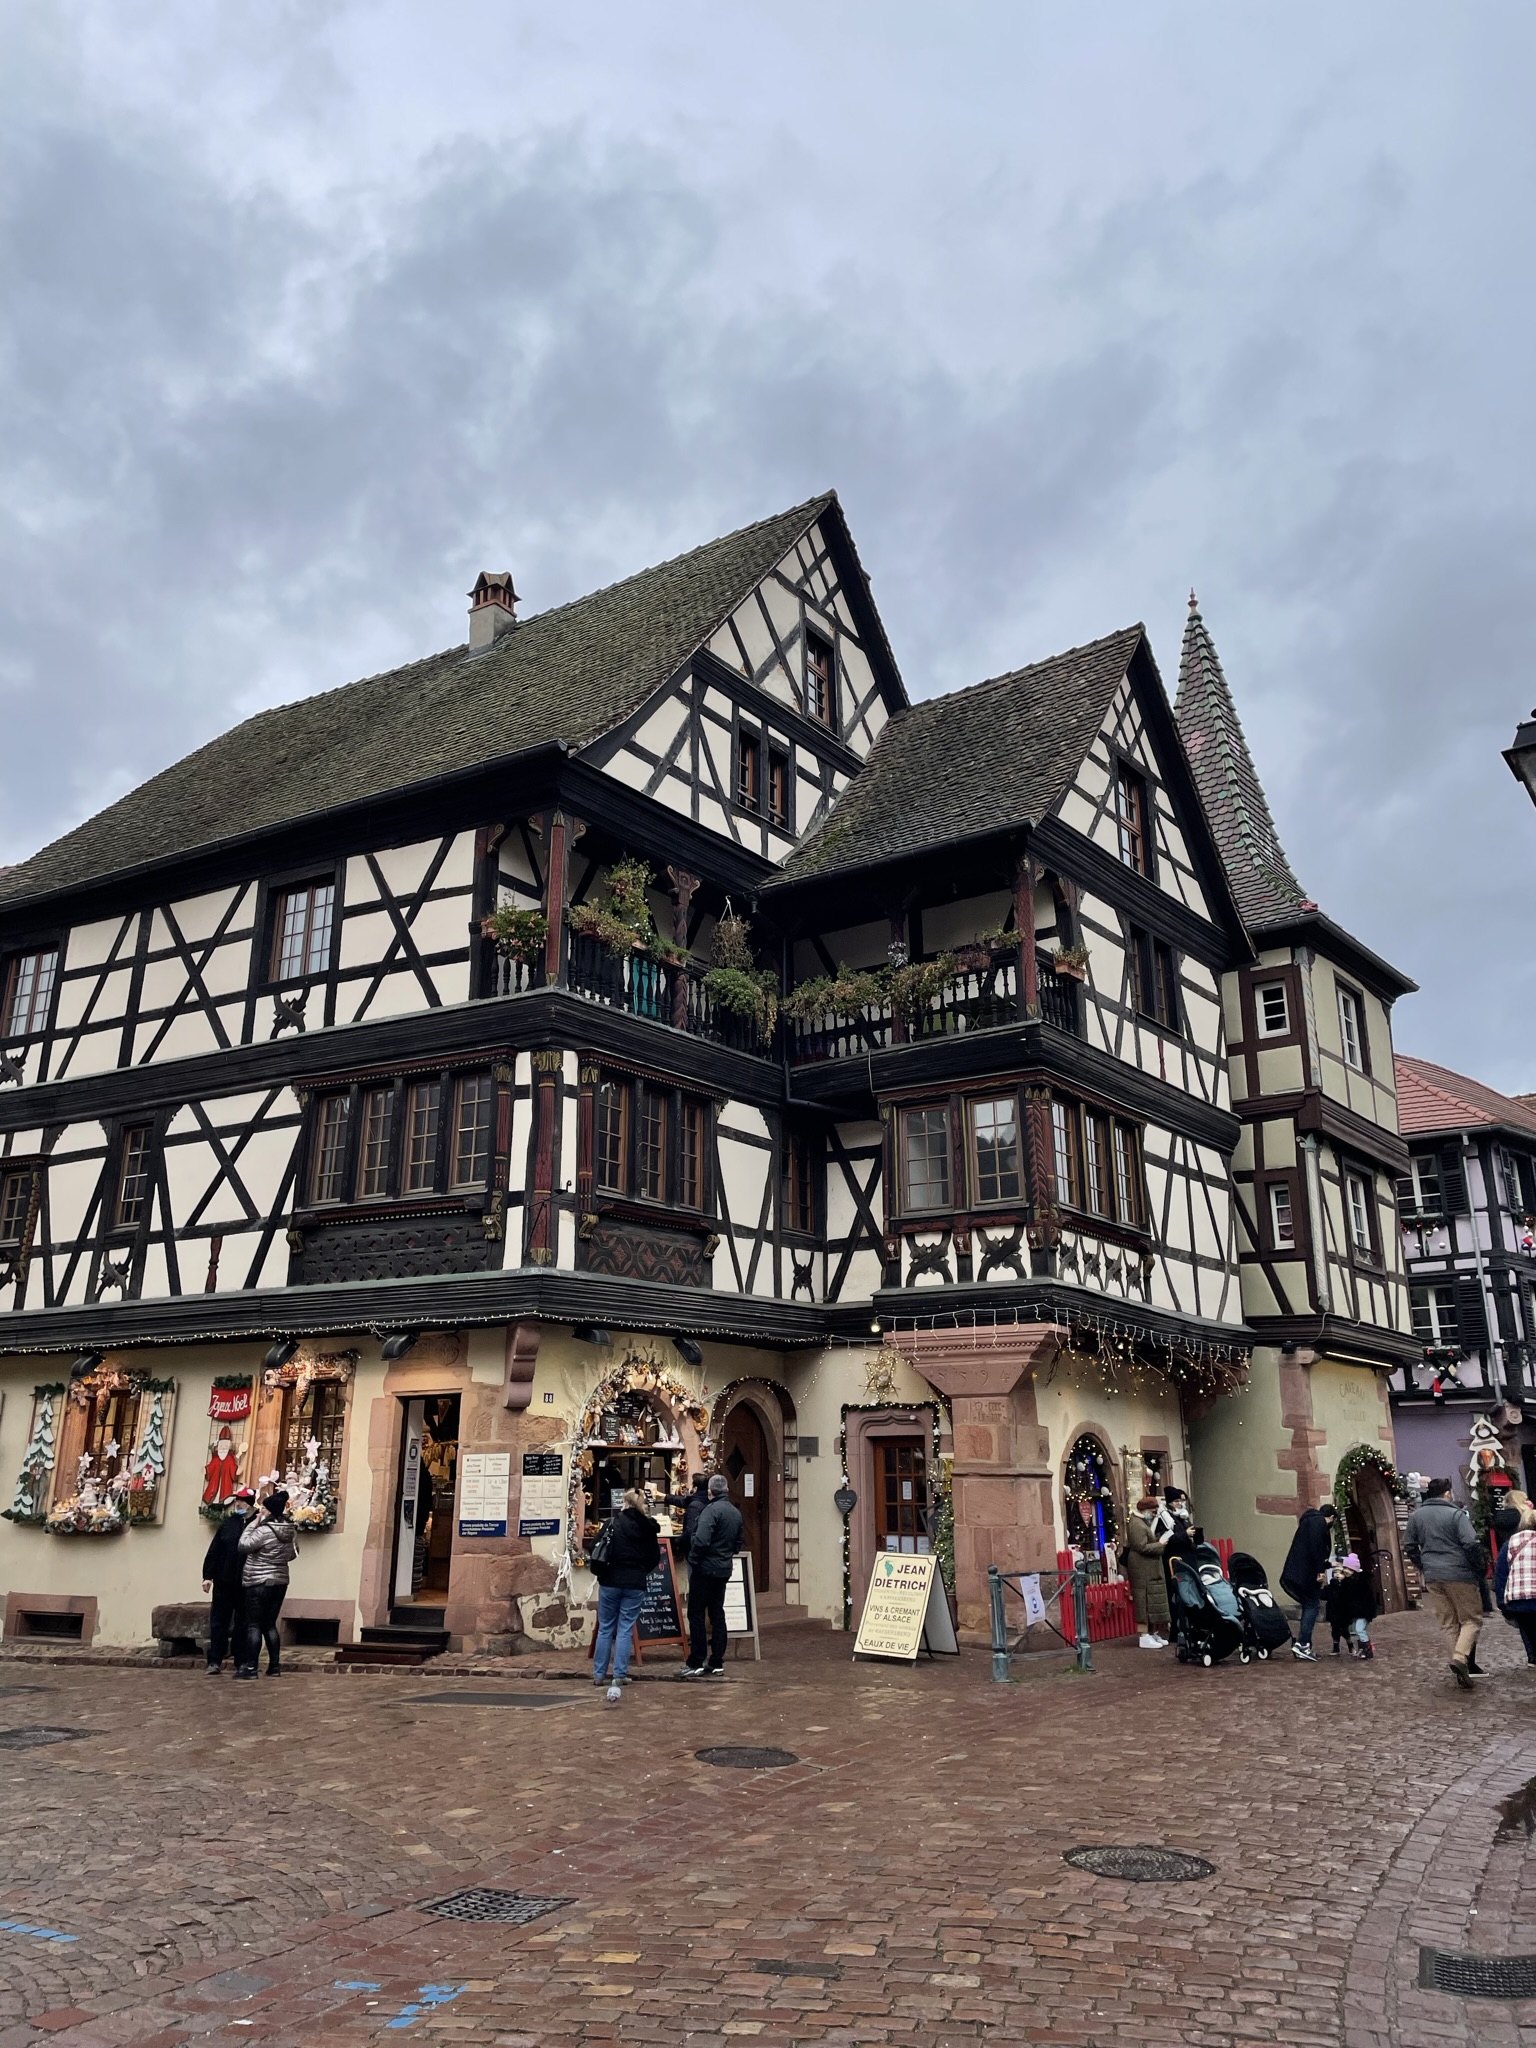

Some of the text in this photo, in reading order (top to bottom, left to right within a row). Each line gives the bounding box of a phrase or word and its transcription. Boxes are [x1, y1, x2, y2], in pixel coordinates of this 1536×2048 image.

[897, 1565, 926, 1575] JEAN
[875, 1578, 926, 1591] DIETRICH
[891, 1607, 920, 1616] CREMANT
[883, 1614, 911, 1623] ALSACE
[864, 1639, 885, 1648] EAUX
